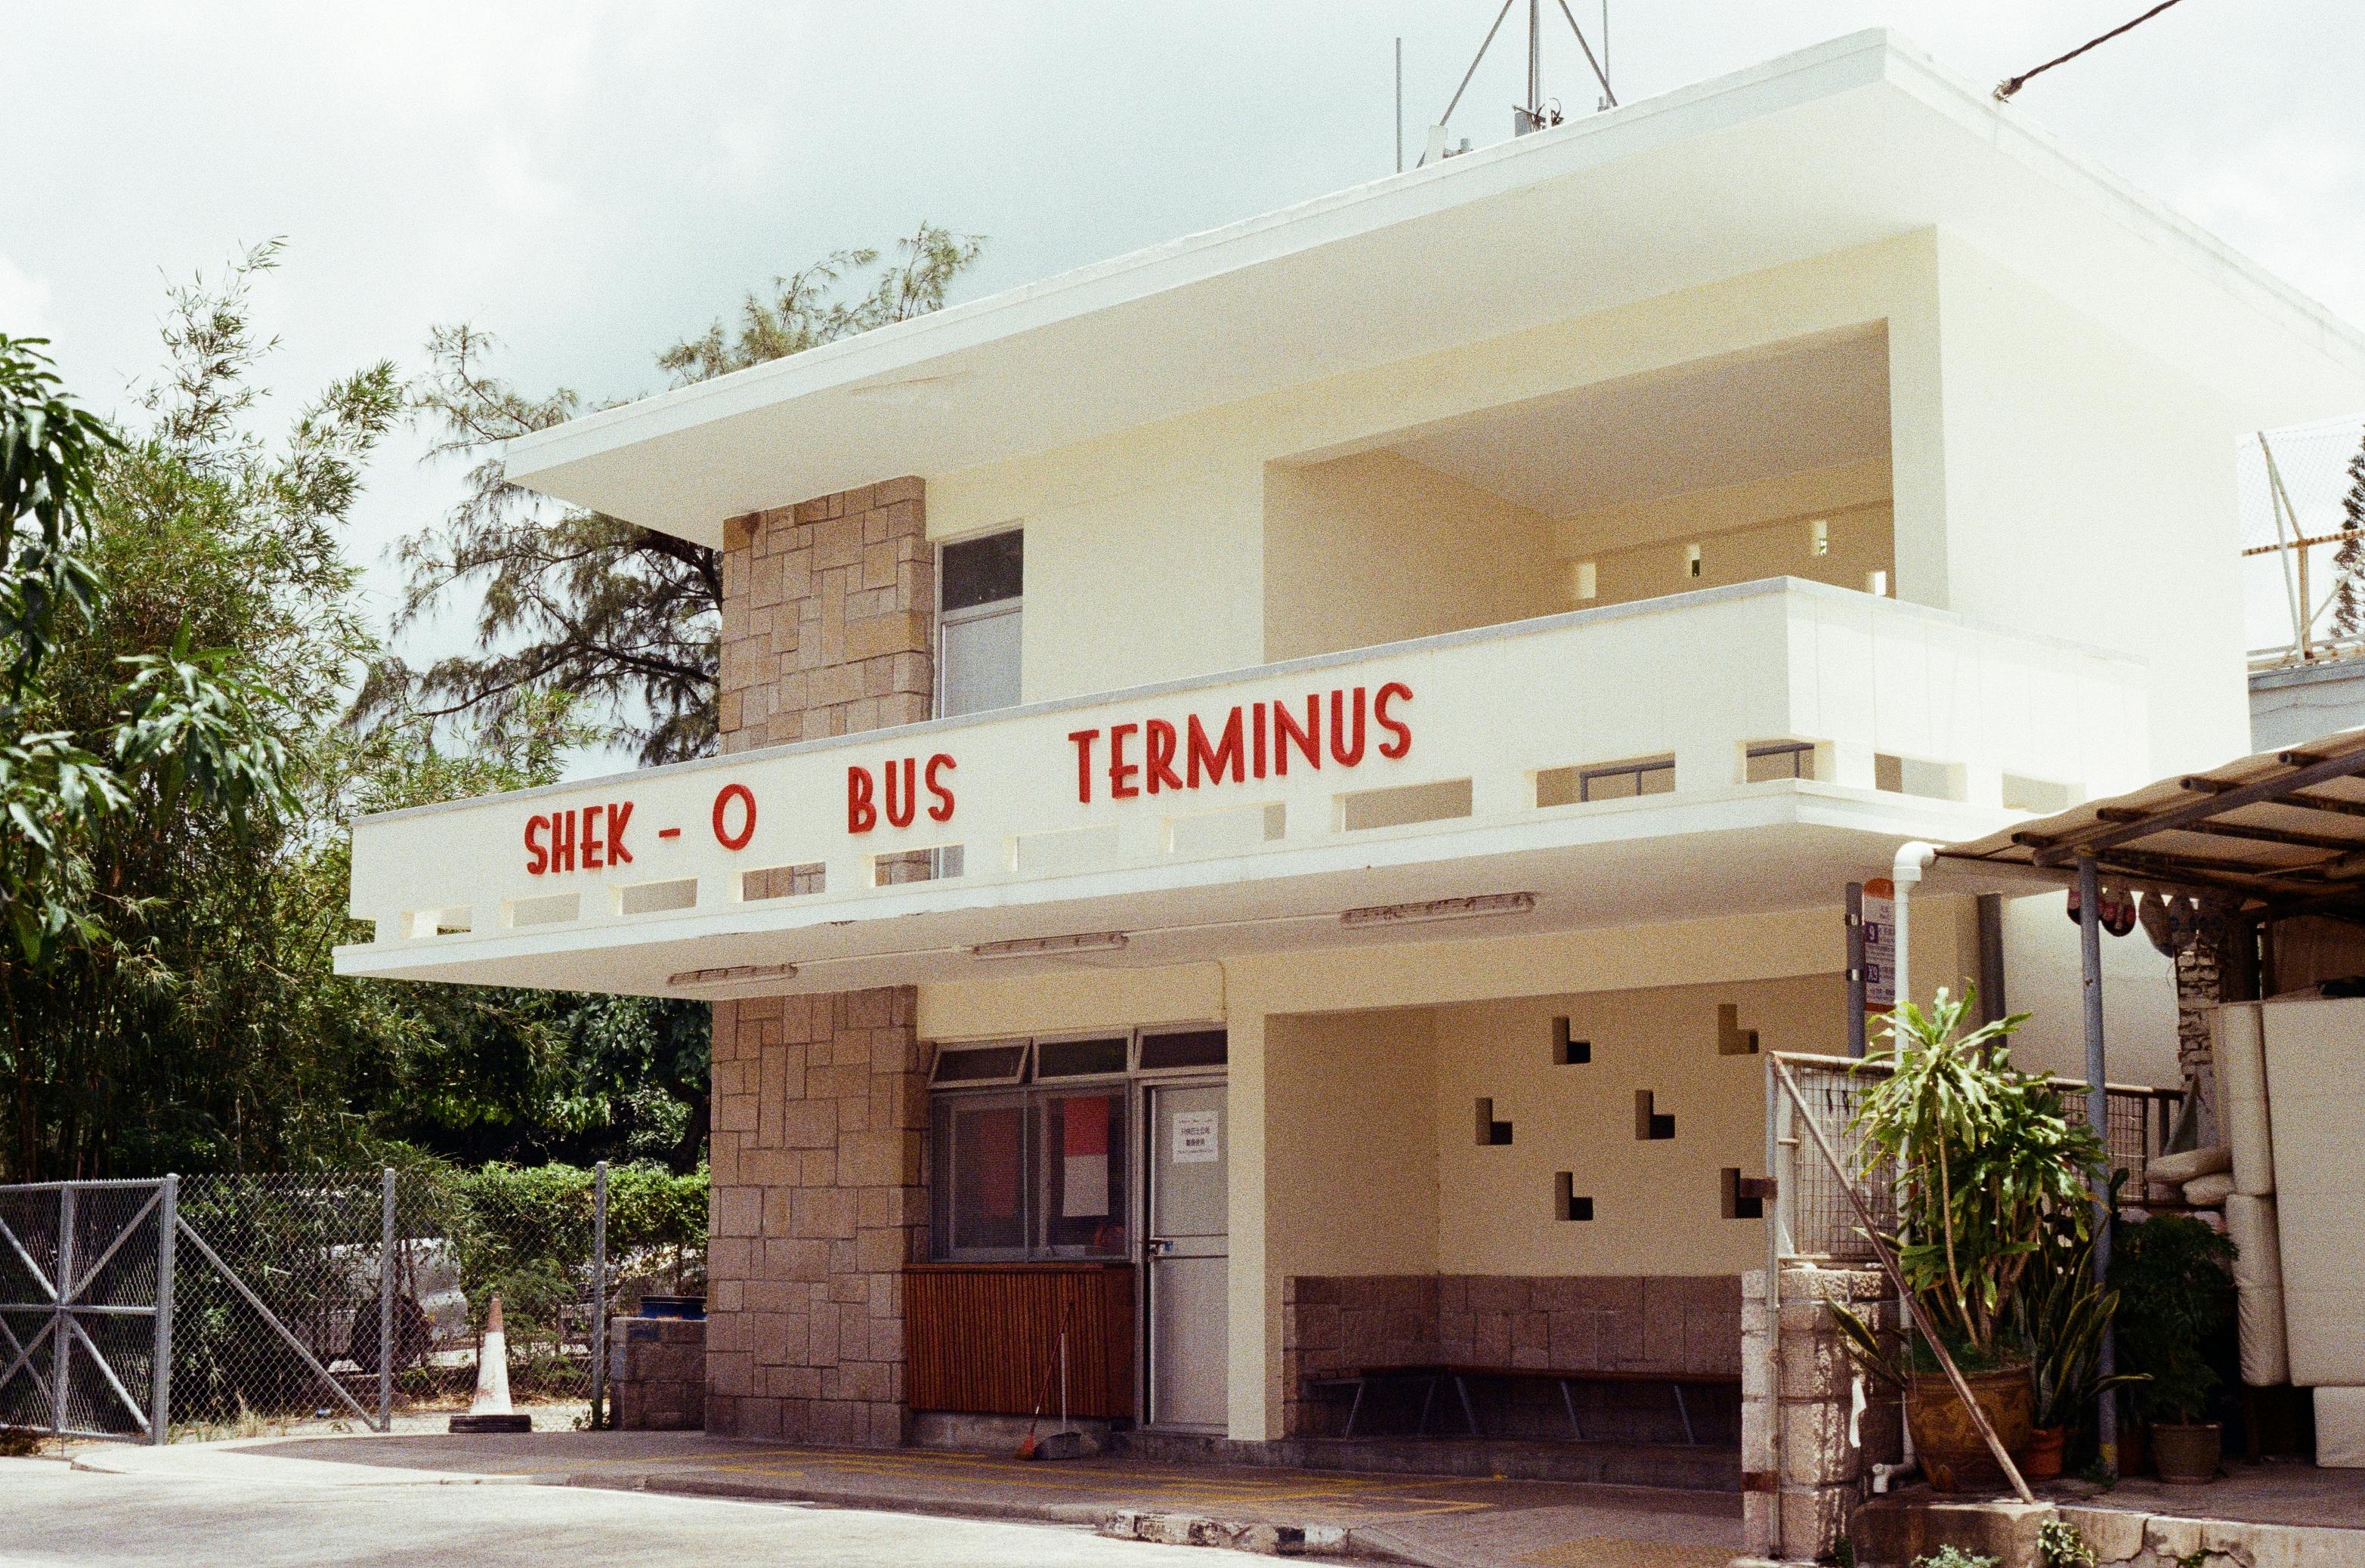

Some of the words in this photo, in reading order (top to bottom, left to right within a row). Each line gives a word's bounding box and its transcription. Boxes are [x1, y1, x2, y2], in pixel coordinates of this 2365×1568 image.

[524, 801, 633, 875] SHEK
[712, 784, 757, 851] O
[848, 753, 957, 834] BUS
[1068, 682, 1413, 803] TERMINUS
[1868, 965, 1878, 982] X9
